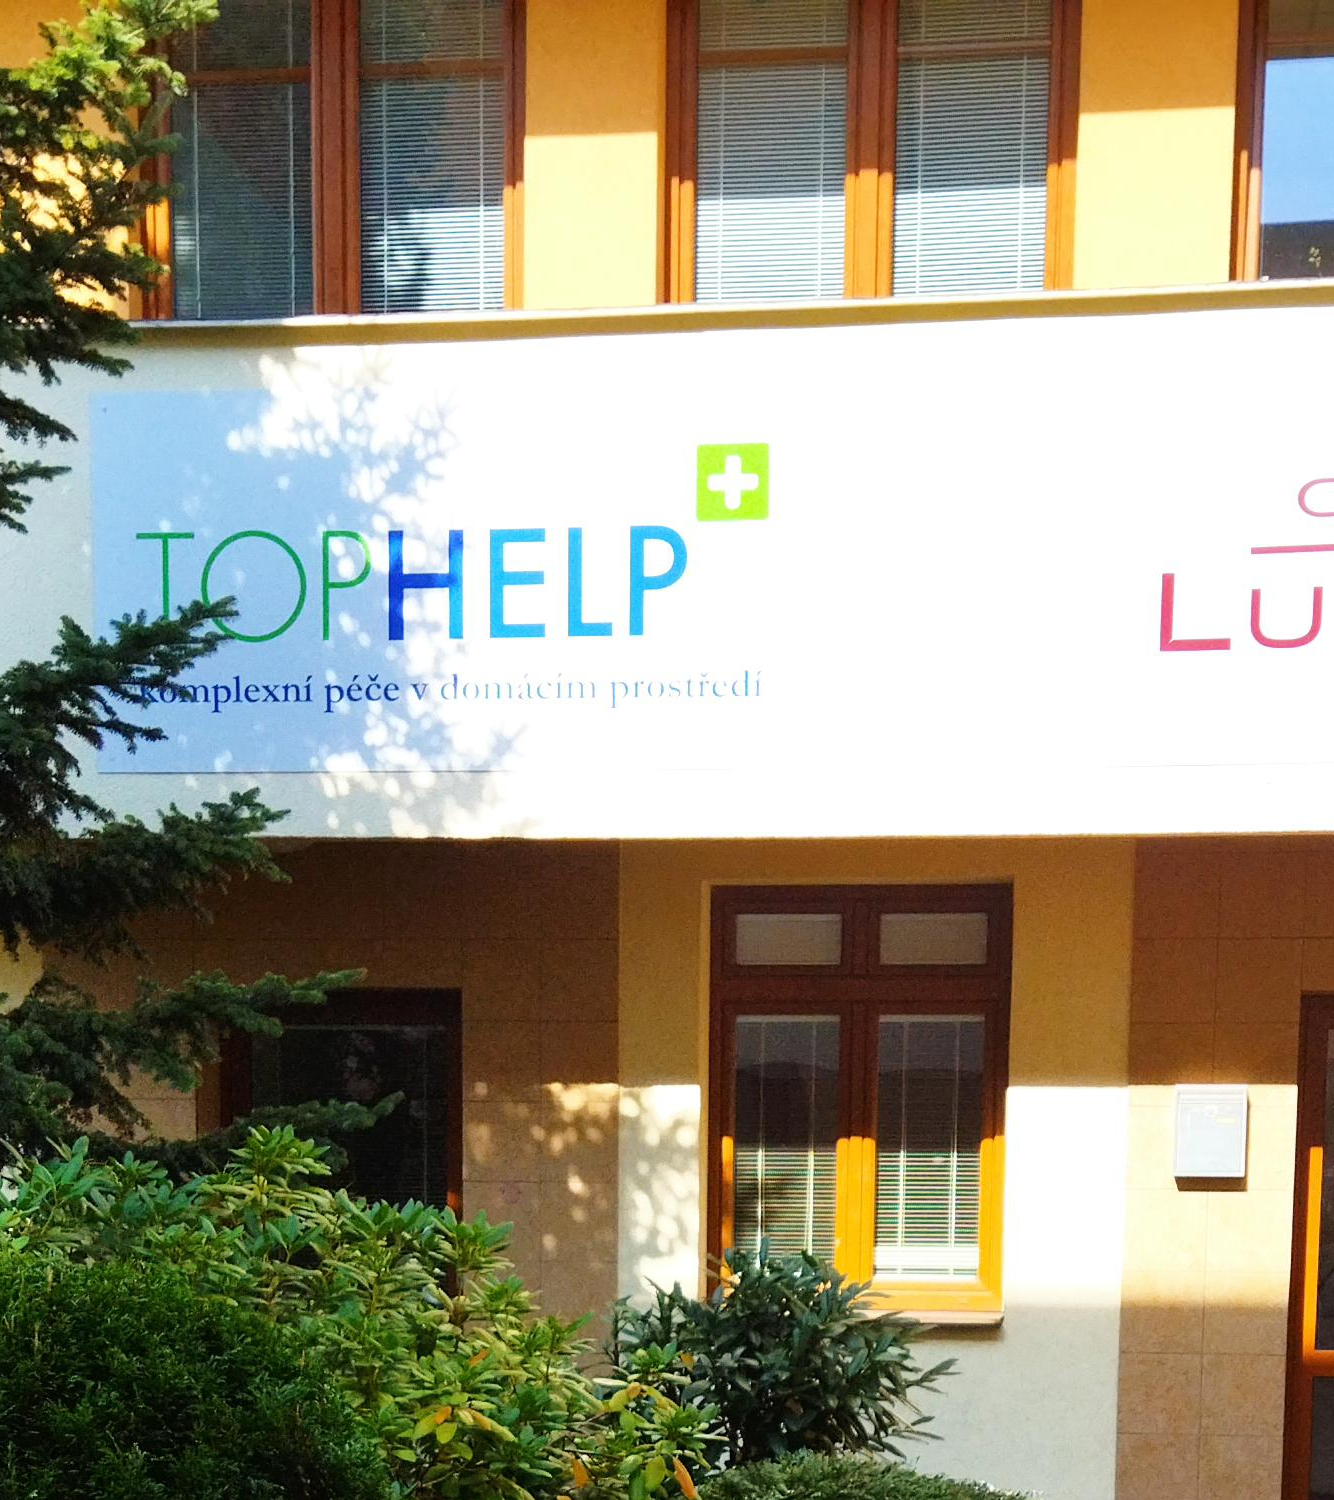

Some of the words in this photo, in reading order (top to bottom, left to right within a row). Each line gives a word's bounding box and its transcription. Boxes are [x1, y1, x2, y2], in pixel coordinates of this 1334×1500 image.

[136, 525, 688, 642] TOPHELP
[325, 674, 399, 713] péče
[412, 682, 427, 700] v
[440, 674, 597, 700] domácím
[612, 670, 763, 708] prostředí
